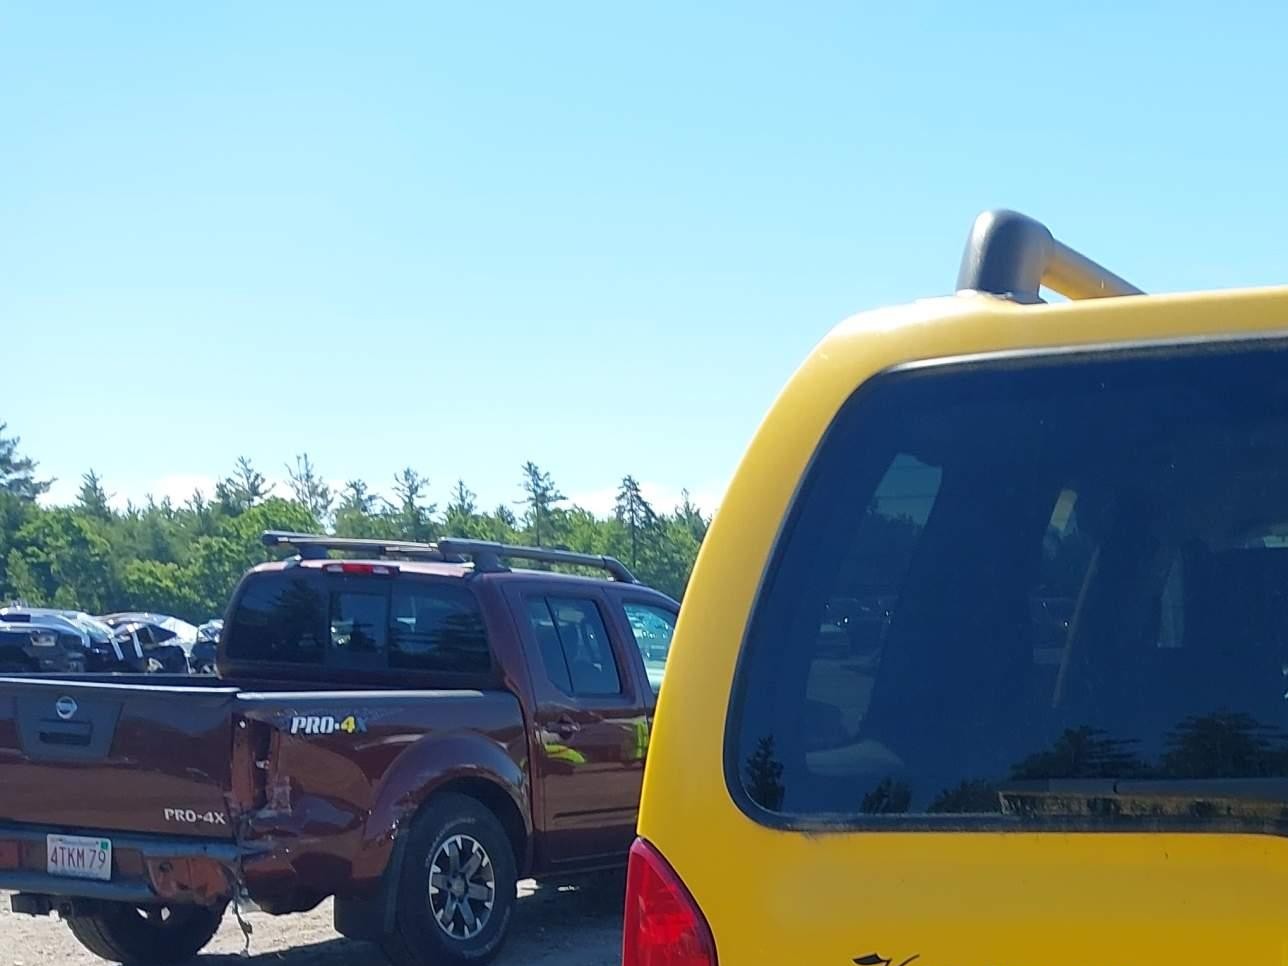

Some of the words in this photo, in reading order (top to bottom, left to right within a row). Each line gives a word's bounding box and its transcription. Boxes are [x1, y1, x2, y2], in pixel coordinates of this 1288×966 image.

[163, 808, 226, 825] PRO-4X
[51, 846, 85, 869] 4TKM
[89, 849, 106, 870] 79
